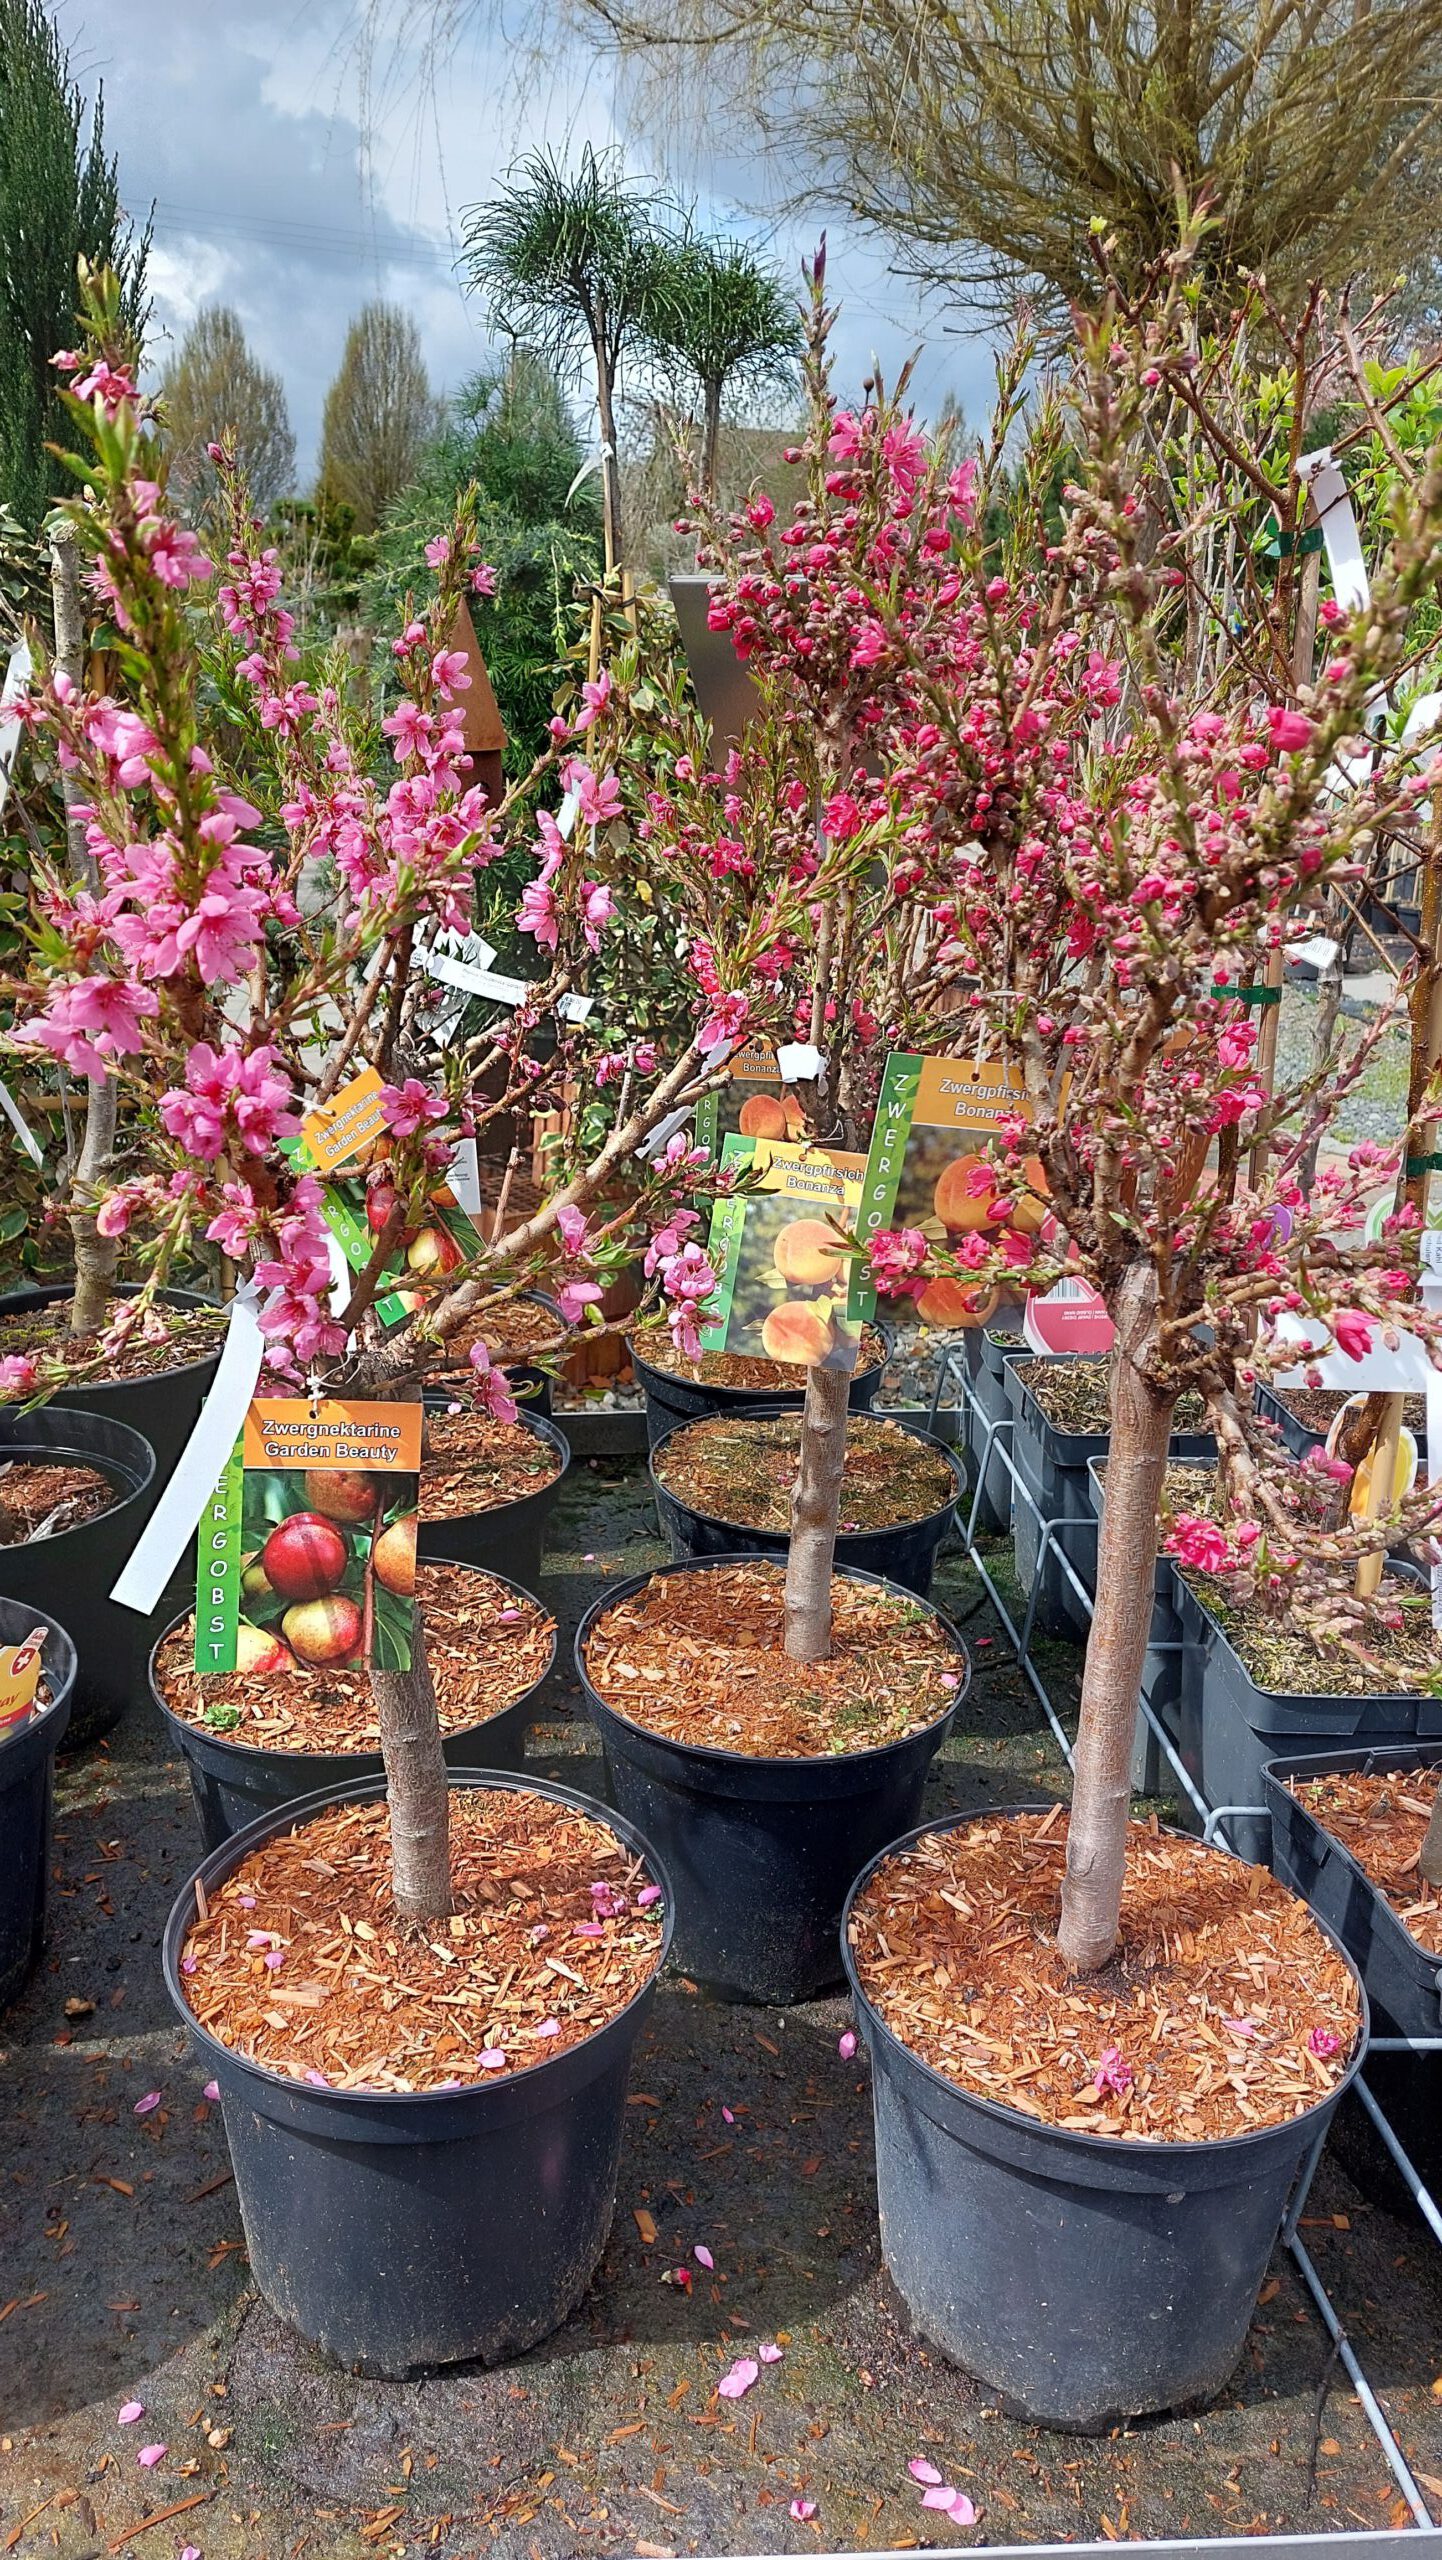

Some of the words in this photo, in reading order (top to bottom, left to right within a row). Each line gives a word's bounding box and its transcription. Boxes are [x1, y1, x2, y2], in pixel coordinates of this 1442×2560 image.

[938, 1078, 1029, 1100] Zwergpfirsi
[313, 1089, 379, 1145] Zwergnektarine
[324, 1129, 358, 1158] Garden
[357, 1107, 383, 1135] Beaut
[772, 1156, 865, 1181] Zwergpfirsich
[786, 1175, 846, 1197] Bonanza
[856, 1073, 911, 1307] ZWERGOST
[261, 1419, 401, 1440] Zwergnektarine
[264, 1441, 331, 1459] Garden
[335, 1443, 399, 1463] Beauty
[208, 1474, 229, 1661] ERGOBST
